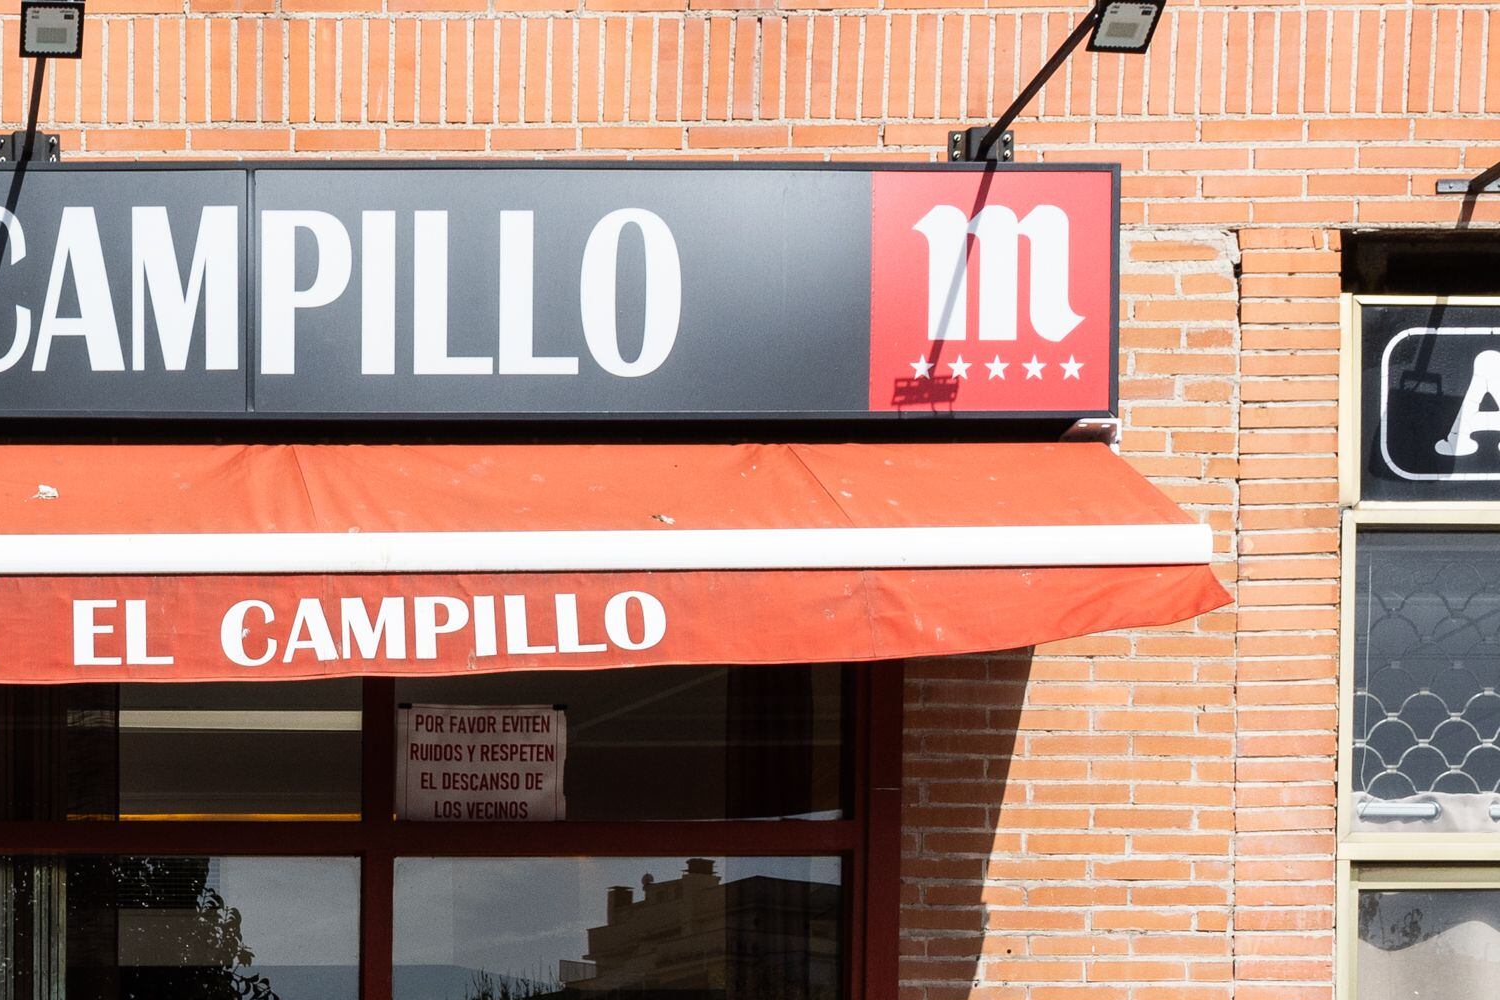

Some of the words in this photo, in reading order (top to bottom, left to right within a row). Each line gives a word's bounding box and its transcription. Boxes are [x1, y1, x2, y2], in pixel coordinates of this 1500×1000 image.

[72, 598, 175, 667] EL
[220, 590, 668, 667] CAMPILLO
[415, 714, 444, 733] POR
[449, 715, 497, 734] FAVOR
[502, 715, 550, 733] EVITEN
[410, 743, 463, 762] RUIDOS
[466, 744, 476, 762] Y
[480, 744, 555, 762] RESPETEN
[420, 772, 438, 790] EL
[442, 772, 520, 791] DESCANSO
[525, 772, 544, 790] DE
[434, 800, 462, 818] LOS
[466, 801, 529, 819] VECINOS
